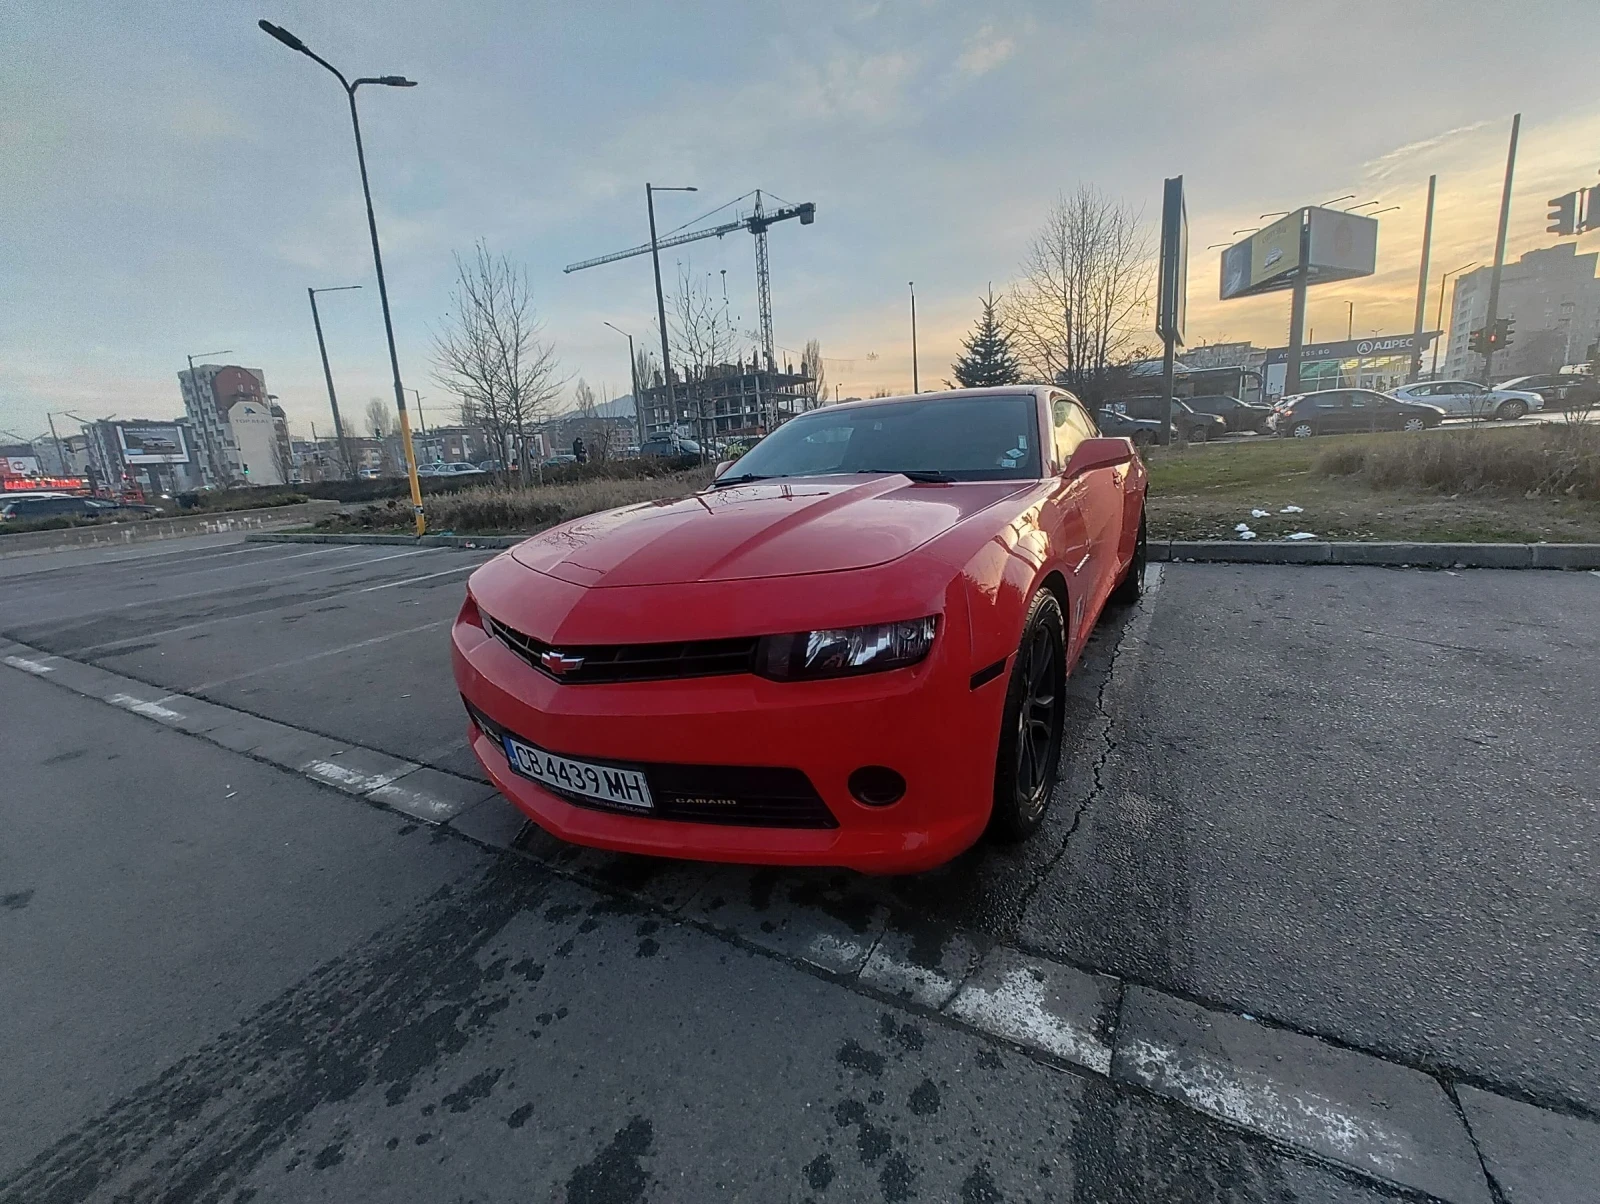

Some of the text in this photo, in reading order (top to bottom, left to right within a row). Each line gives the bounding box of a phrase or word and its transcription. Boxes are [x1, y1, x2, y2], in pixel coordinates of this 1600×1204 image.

[1373, 338, 1414, 351] АДРЕС
[515, 745, 544, 777] CB
[546, 756, 600, 794] 4439
[603, 769, 645, 803] MH
[675, 797, 737, 805] CAMARO
